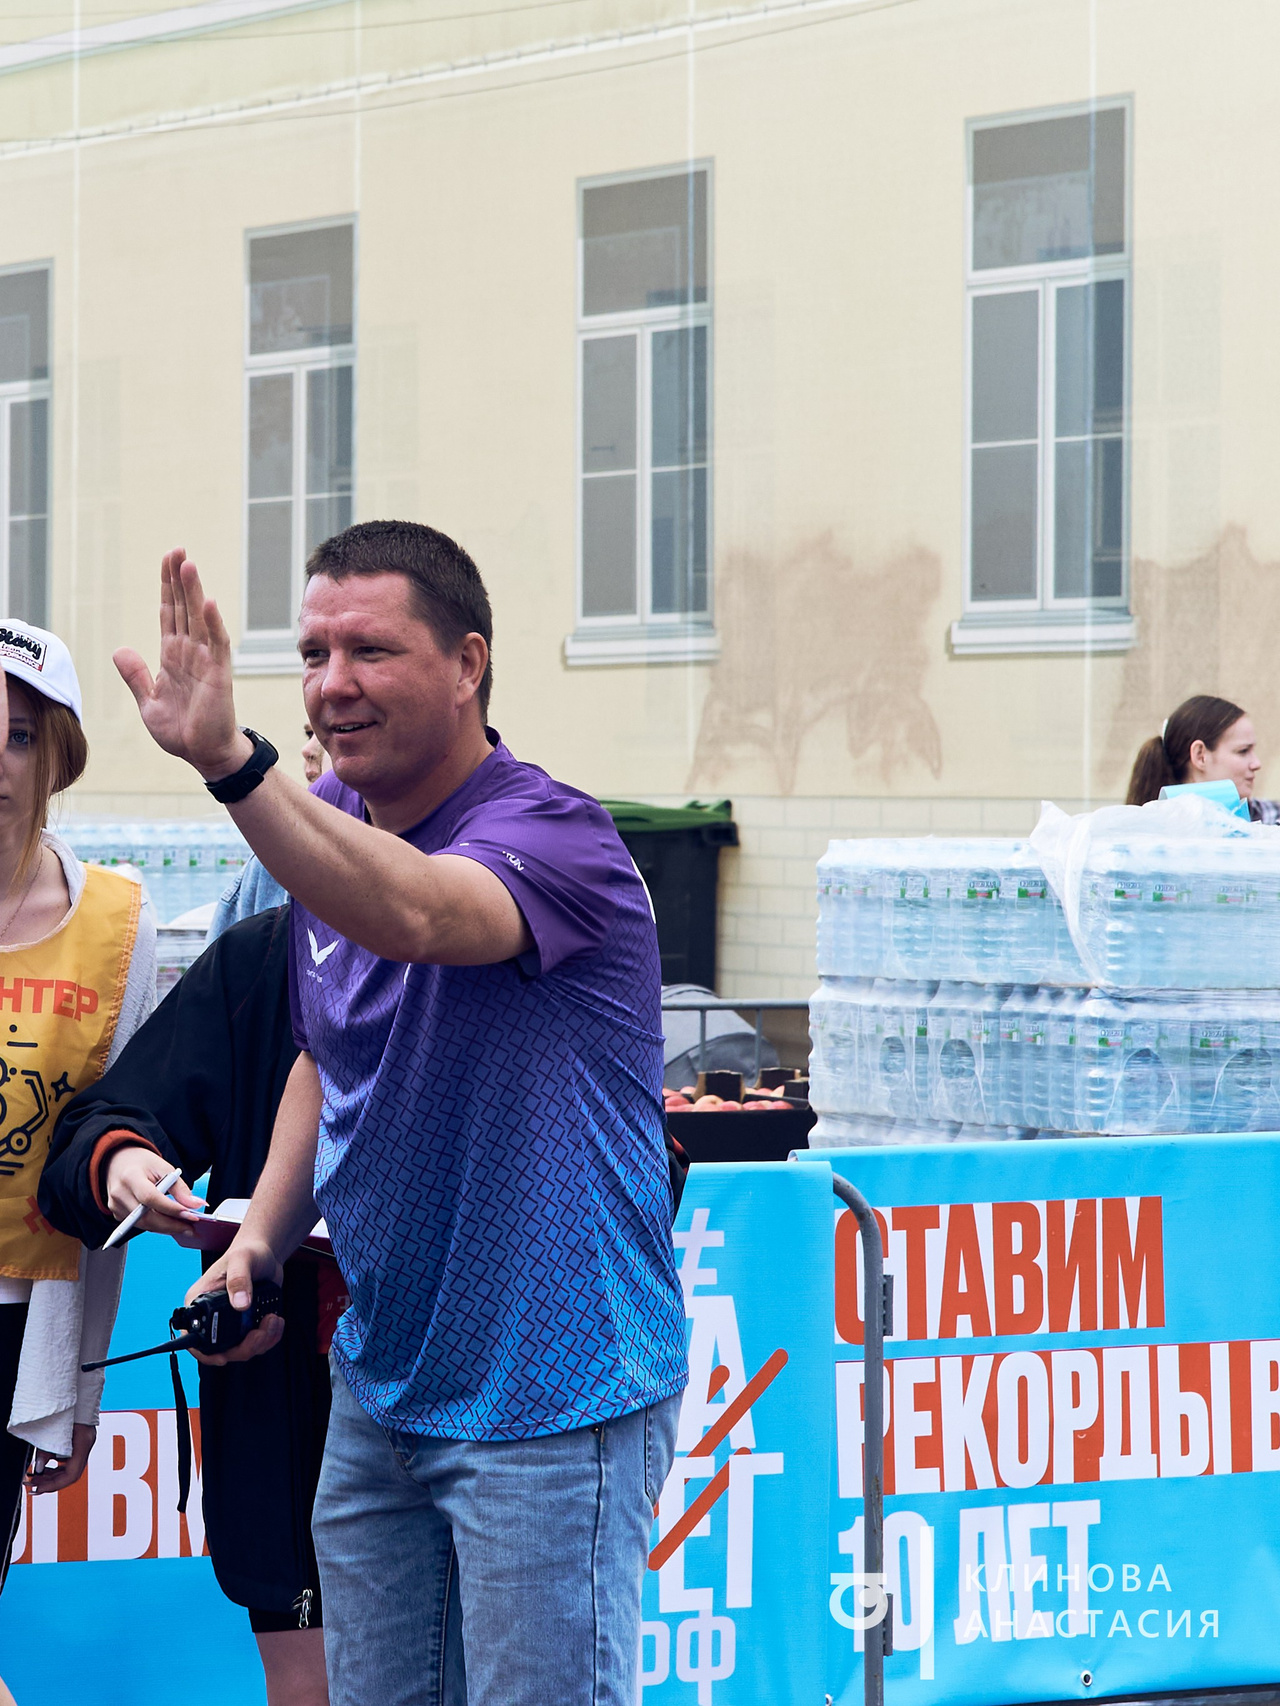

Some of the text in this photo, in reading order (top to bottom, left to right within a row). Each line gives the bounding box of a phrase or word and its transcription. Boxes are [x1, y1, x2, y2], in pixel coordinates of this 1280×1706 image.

[834, 1195, 1166, 1346] СТАВИМ
[836, 1341, 1233, 1499] РЕКОРДЫ
[953, 1499, 1101, 1645] ЛЕТ
